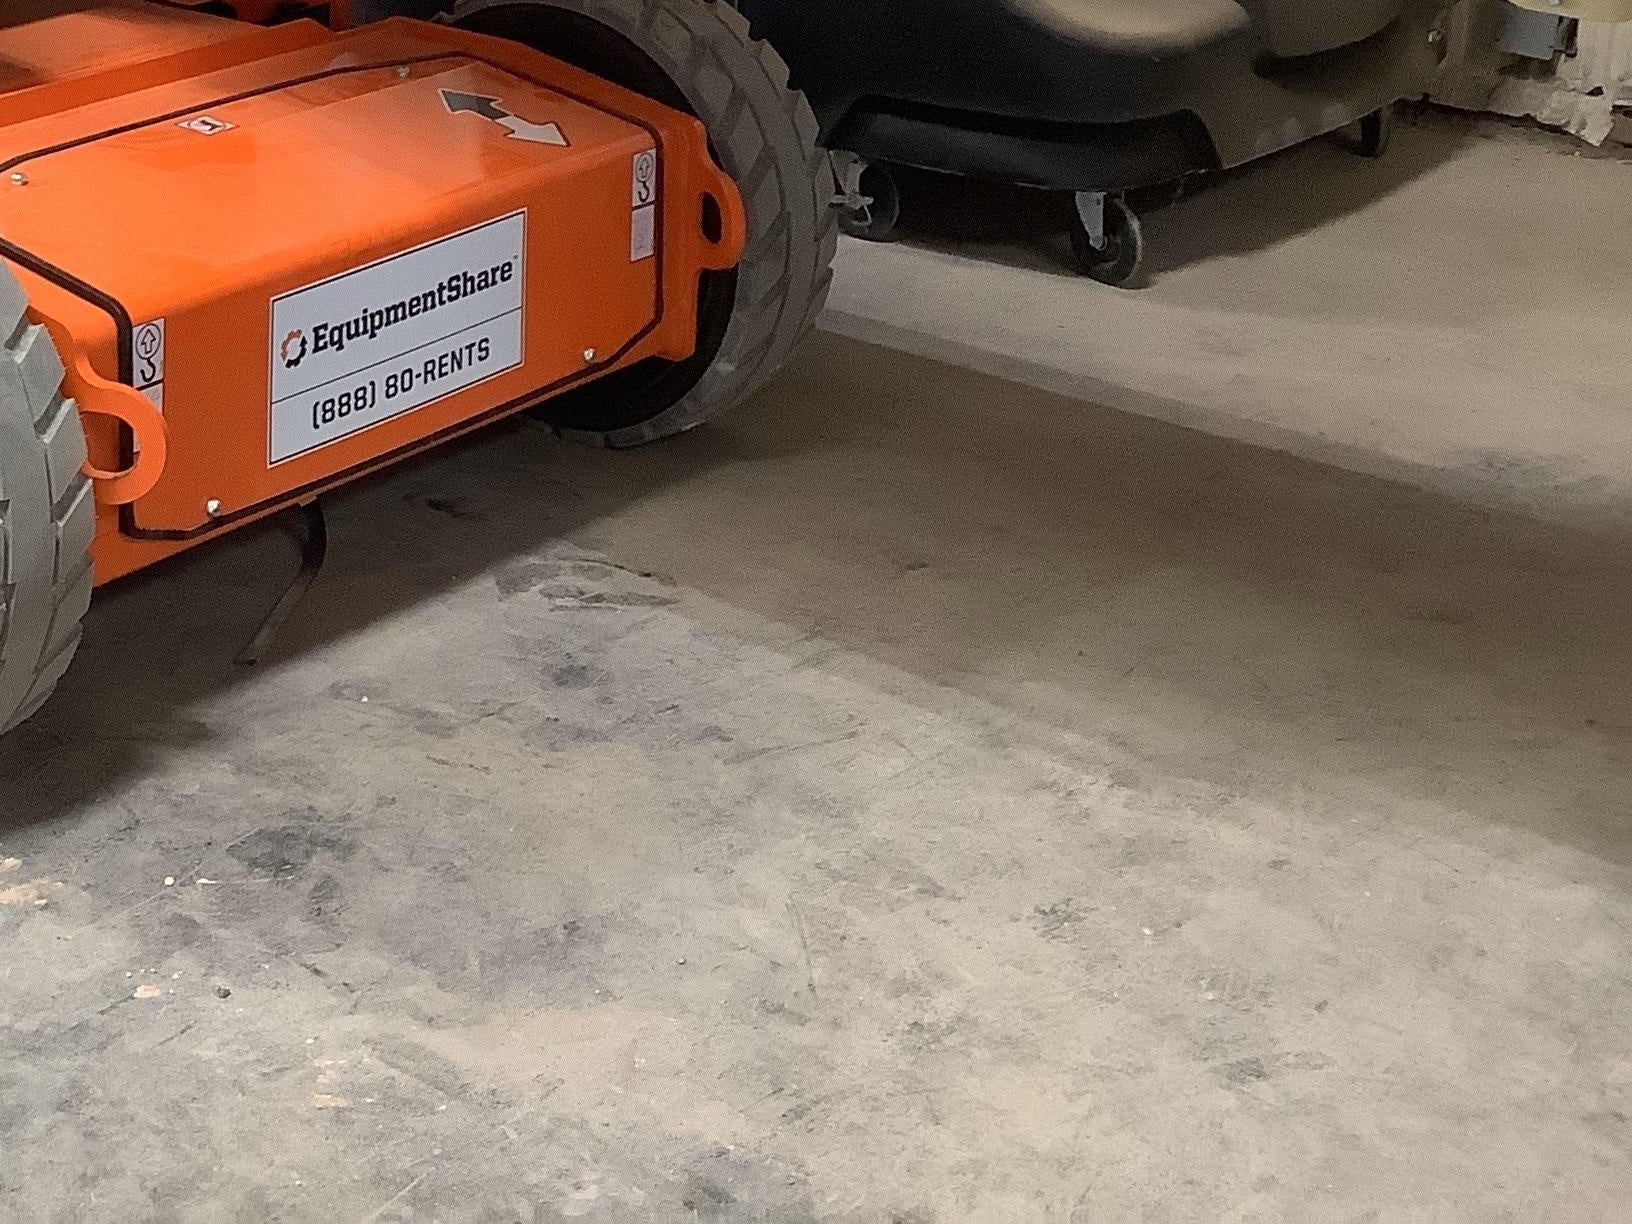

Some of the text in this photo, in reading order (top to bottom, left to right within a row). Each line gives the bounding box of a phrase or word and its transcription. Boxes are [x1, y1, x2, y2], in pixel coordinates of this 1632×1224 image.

[311, 260, 513, 354] EquipmentShare
[312, 337, 490, 430] (888) 80-RENTS
